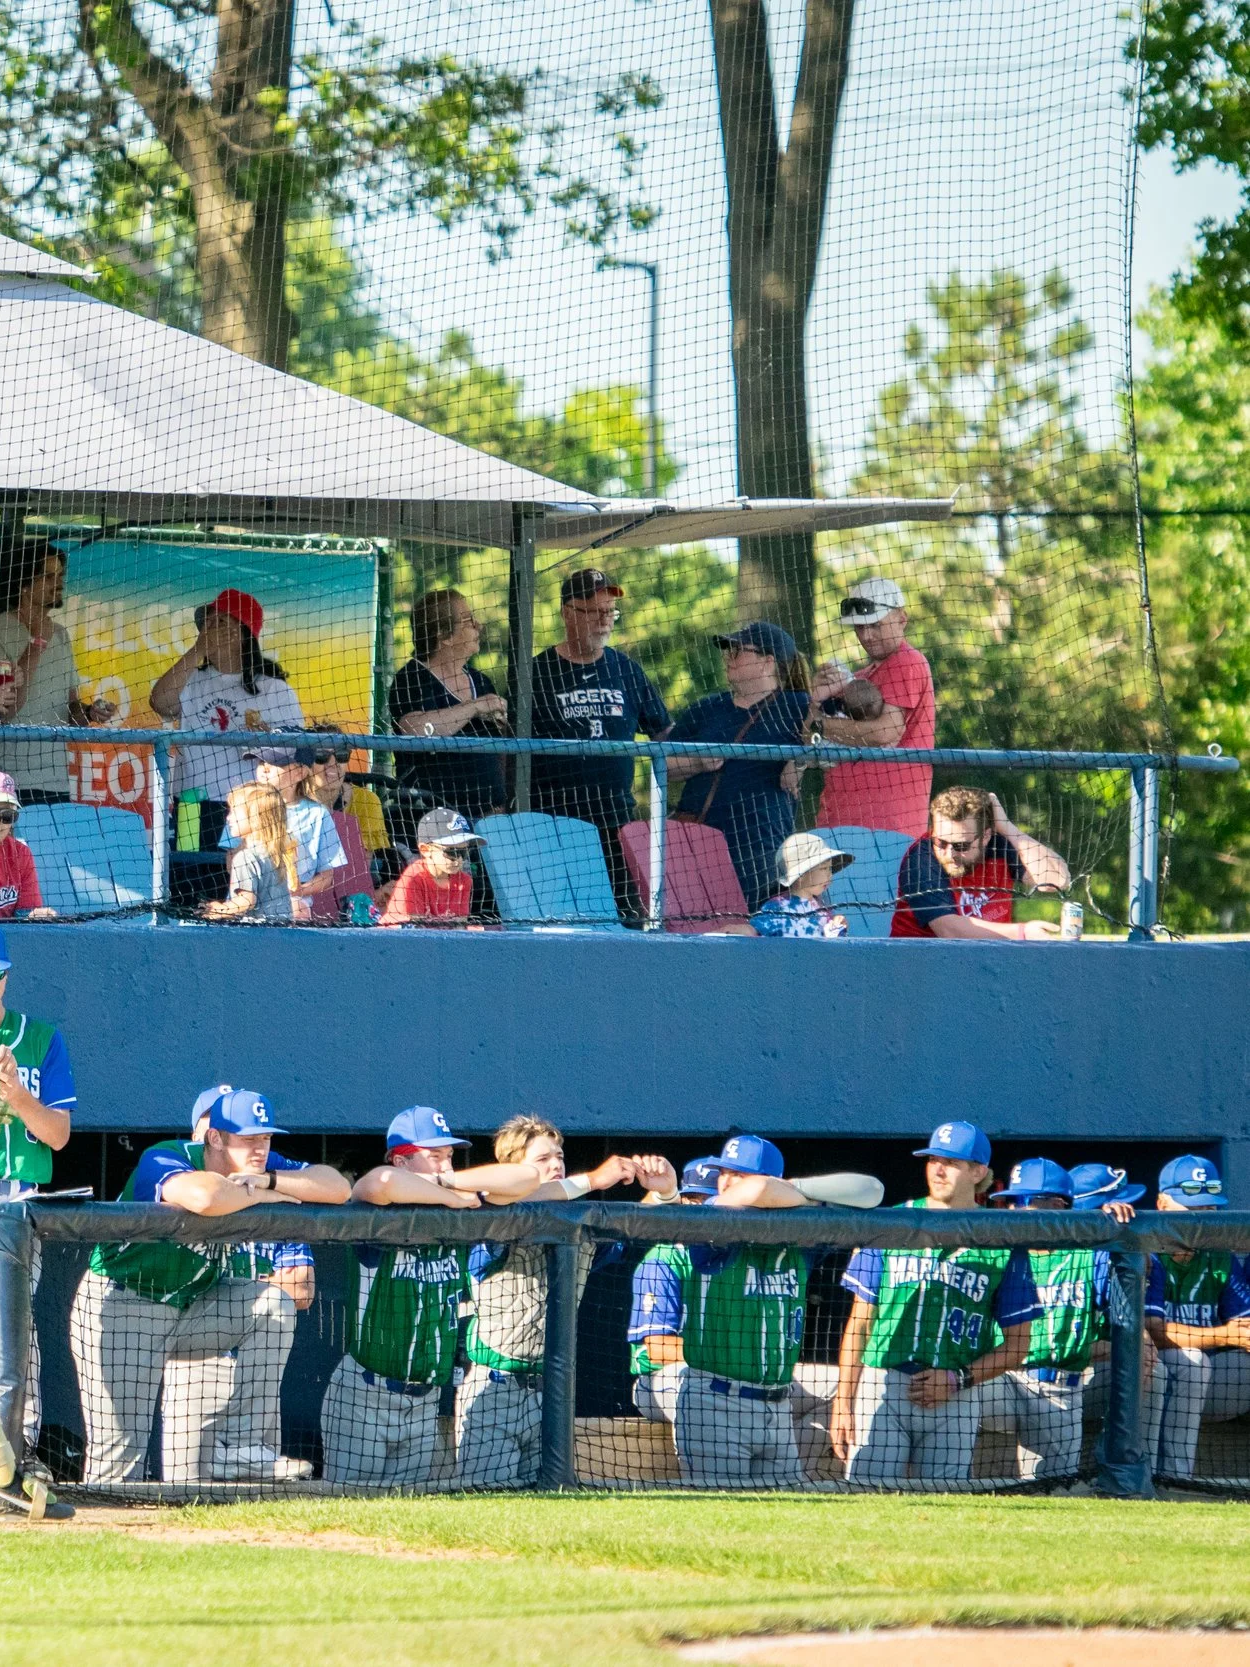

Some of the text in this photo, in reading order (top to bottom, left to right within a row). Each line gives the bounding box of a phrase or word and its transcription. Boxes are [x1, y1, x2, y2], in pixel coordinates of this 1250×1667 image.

[557, 688, 624, 705] TIGERS
[564, 704, 603, 718] BASEBALL
[252, 1102, 269, 1123] GL
[433, 1113, 450, 1133] GL
[938, 1125, 954, 1144] GL
[888, 1255, 989, 1303] MARINERS
[947, 1306, 984, 1349] 44
